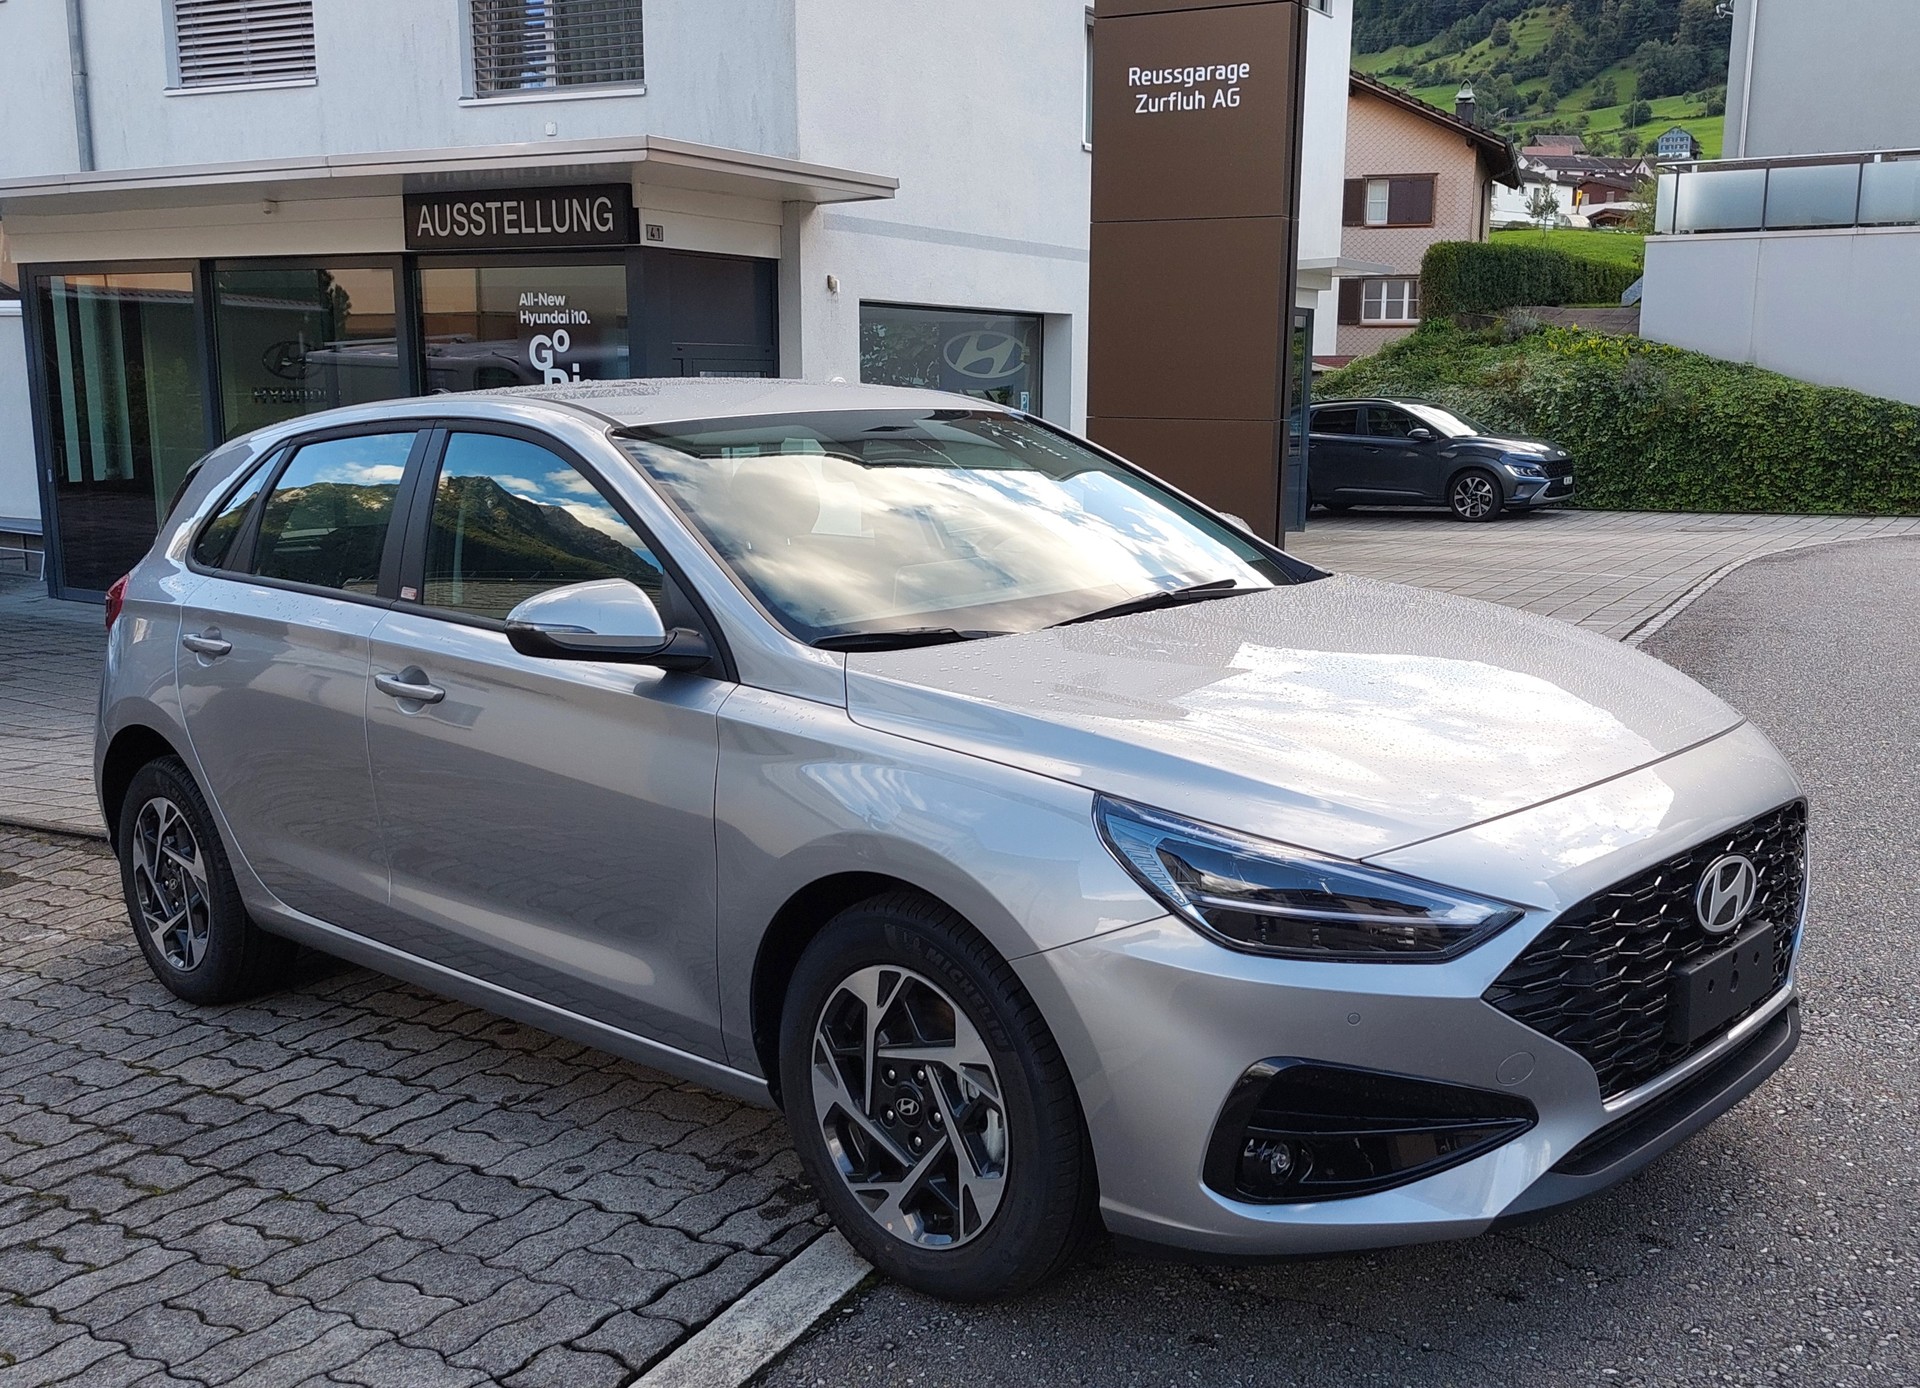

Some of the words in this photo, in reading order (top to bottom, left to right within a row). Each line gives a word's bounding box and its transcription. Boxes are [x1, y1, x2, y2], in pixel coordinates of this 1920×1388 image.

[1128, 63, 1250, 87] Reussgarage
[1135, 91, 1206, 113] Zurfluh
[1212, 87, 1241, 108] AG
[417, 197, 614, 237] AUSSTELLUNG
[650, 227, 661, 239] 41
[519, 292, 566, 306] All-New
[520, 309, 569, 327] Hyundai
[571, 309, 591, 324] i10.
[925, 947, 1010, 1047] MICHELIN
